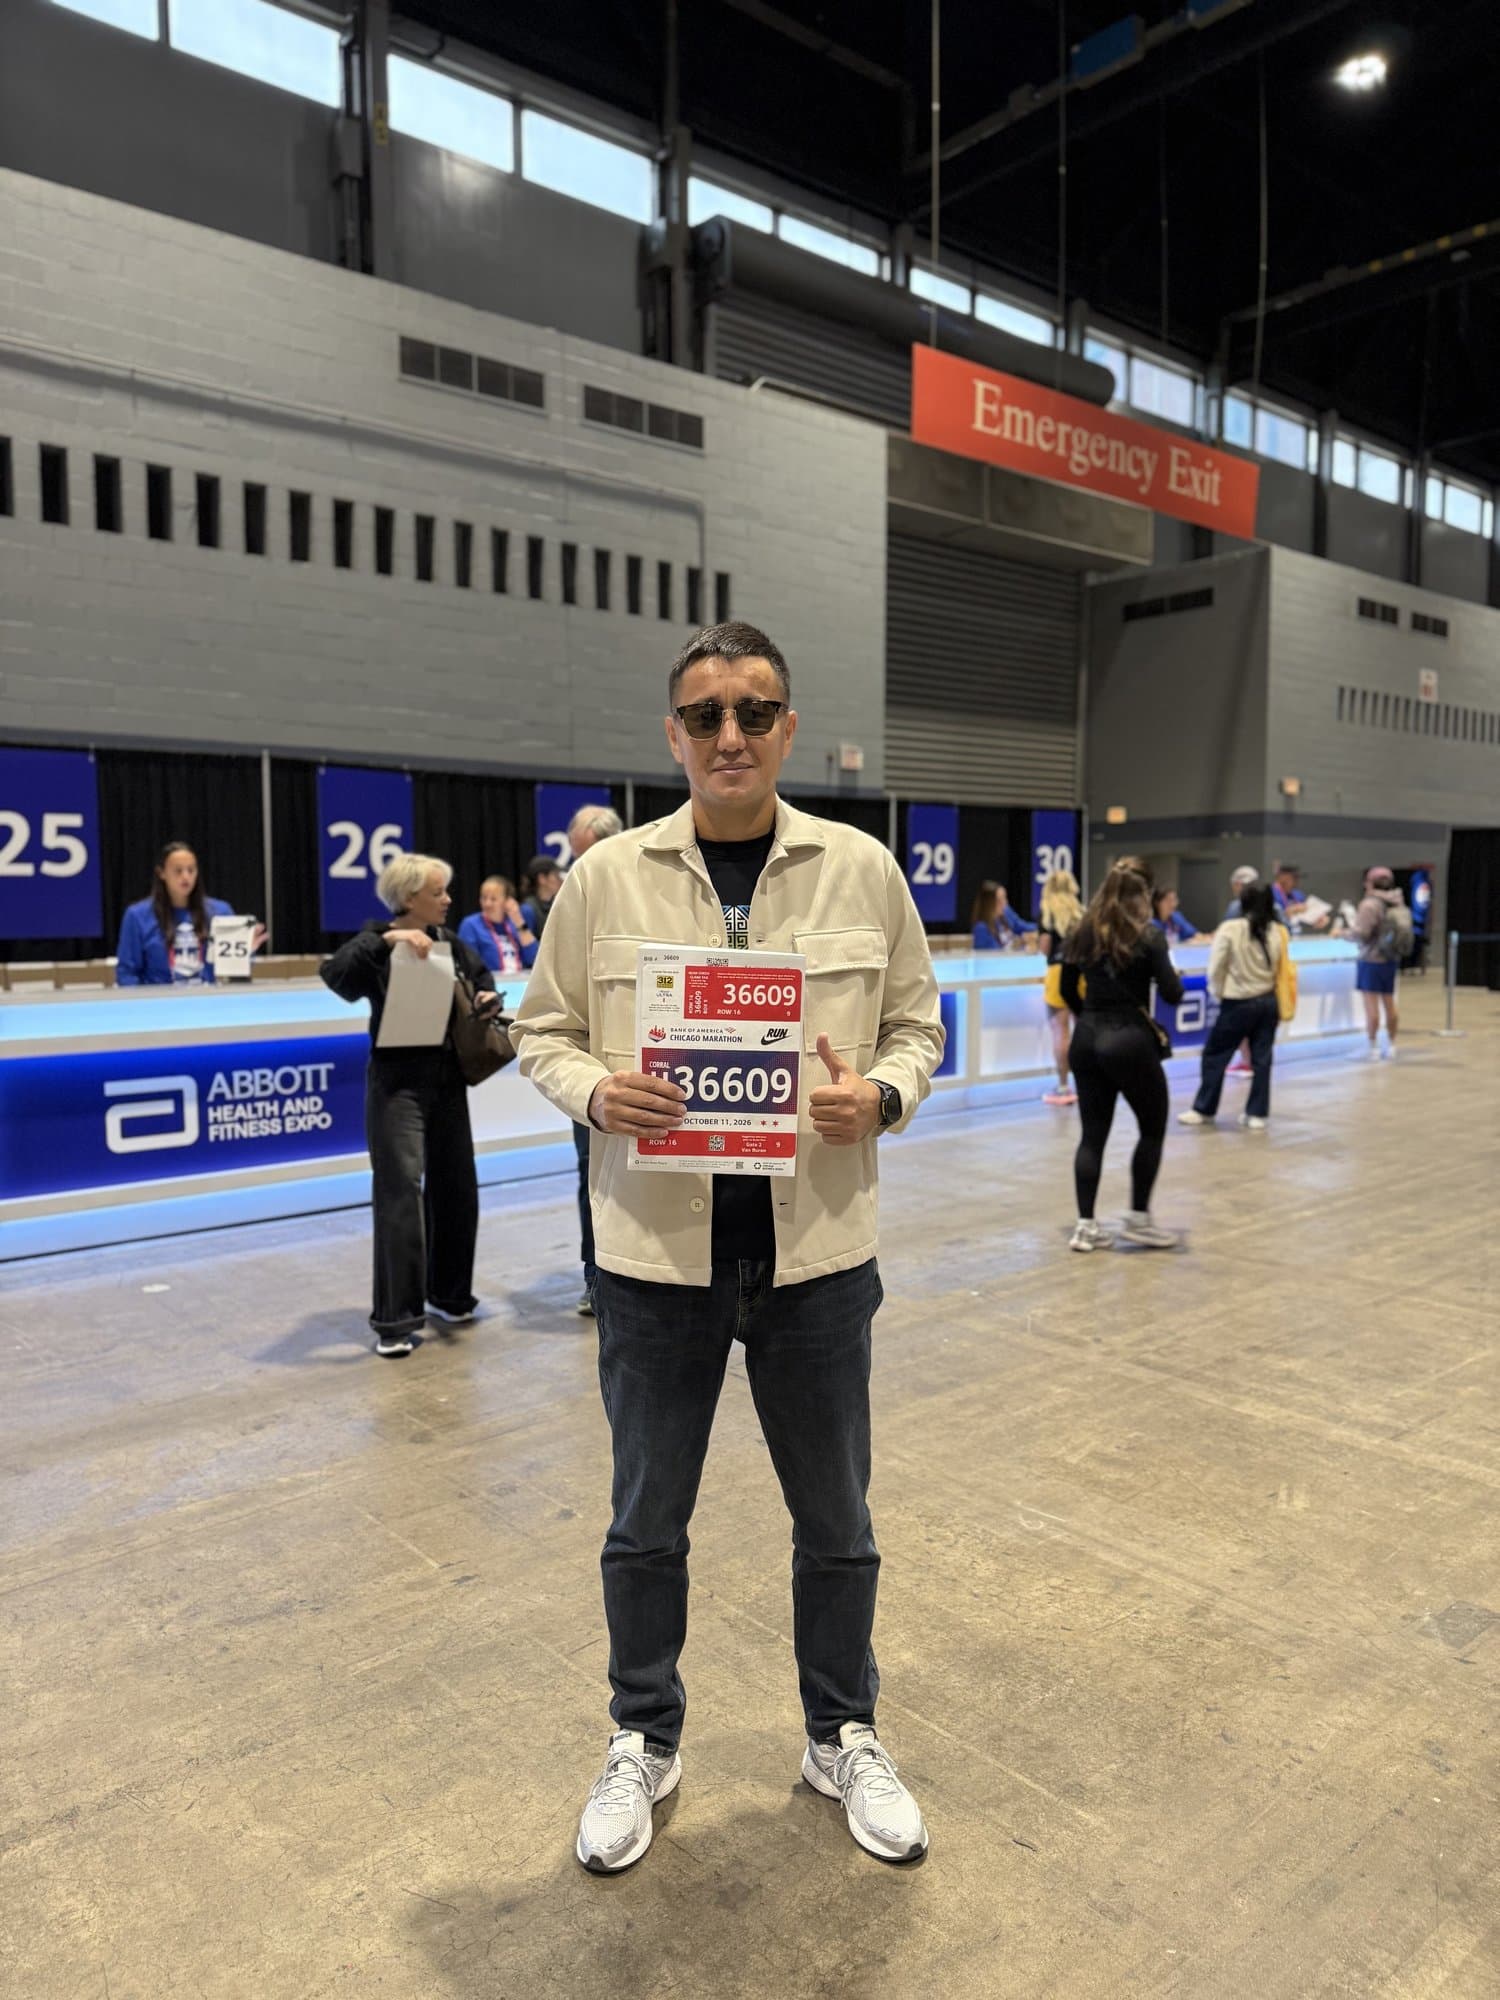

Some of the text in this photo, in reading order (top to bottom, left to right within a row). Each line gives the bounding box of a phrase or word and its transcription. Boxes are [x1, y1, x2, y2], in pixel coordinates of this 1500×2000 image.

[972, 379, 1221, 507] Emergency Exit
[0, 811, 88, 878] 25
[328, 821, 403, 879] 26
[911, 842, 955, 885] 29
[1036, 845, 1073, 884] 30
[218, 941, 248, 958] 25
[657, 976, 673, 985] 312
[723, 983, 796, 1006] 36609
[670, 1034, 743, 1043] CHICAGO MARATHON
[766, 1028, 788, 1039] RUN
[649, 1061, 670, 1069] CORRAL
[207, 1063, 335, 1102] ABBOTT
[674, 1065, 792, 1104] 36609
[208, 1096, 323, 1124] HEALTH AND
[208, 1112, 332, 1142] FITNESS EXPO
